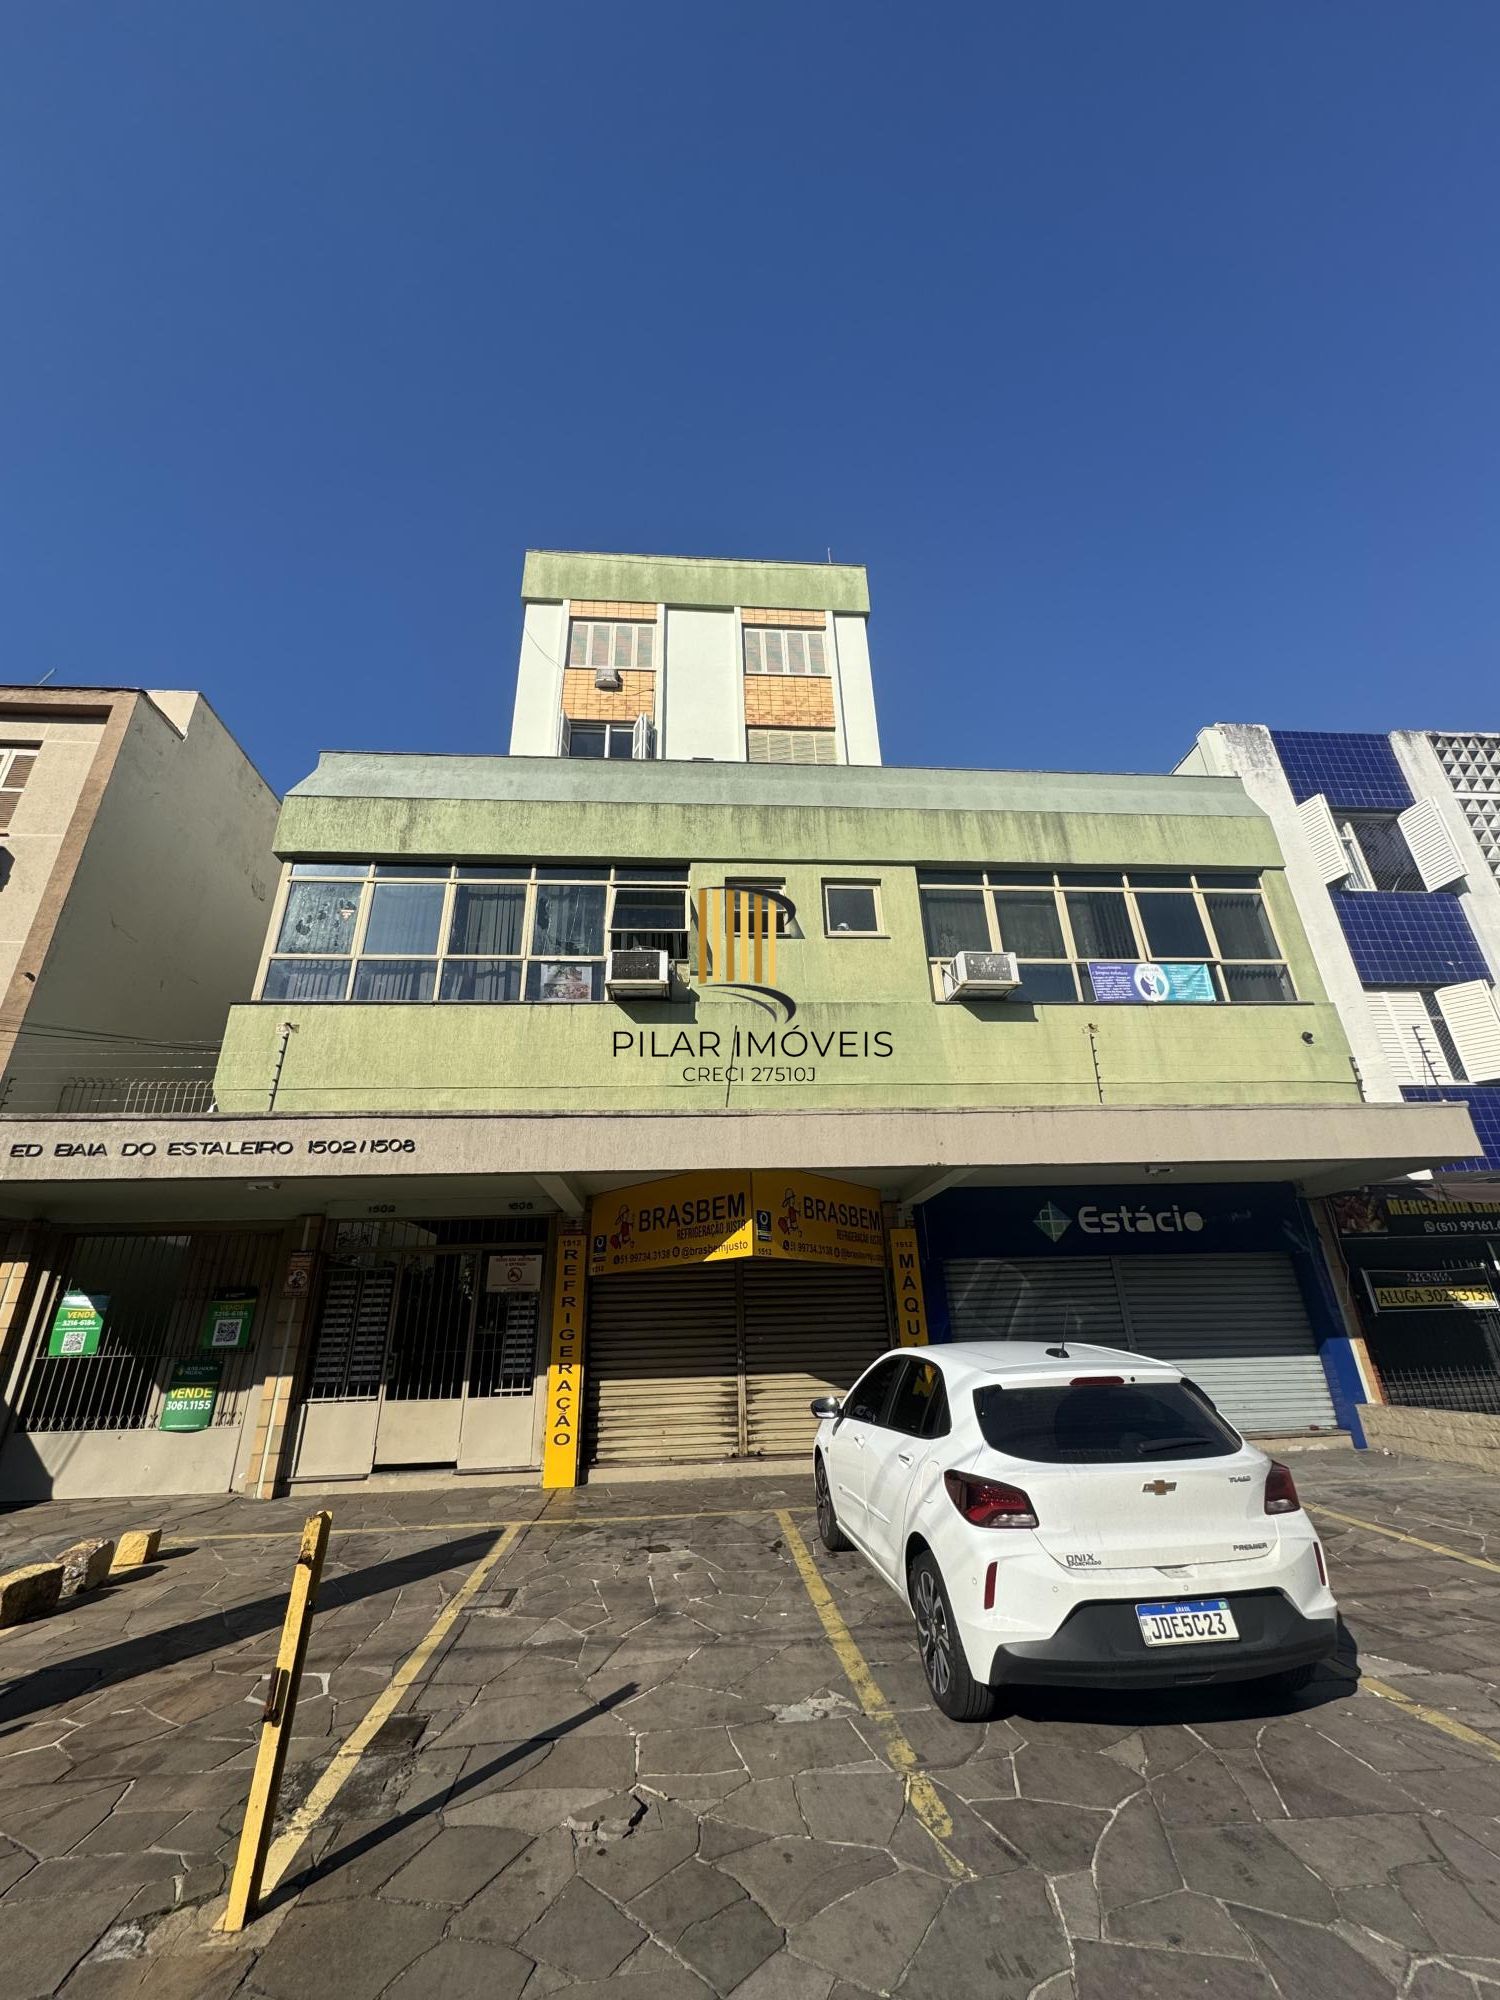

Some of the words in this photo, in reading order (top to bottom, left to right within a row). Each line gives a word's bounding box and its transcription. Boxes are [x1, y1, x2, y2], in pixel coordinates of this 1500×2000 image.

[10, 1143, 43, 1158] ED
[54, 1143, 108, 1158] BAIA
[121, 1142, 157, 1157] DO
[167, 1141, 294, 1157] ESTALEIRO
[368, 1205, 396, 1213] 1502
[639, 1192, 745, 1232] BRASBEM
[803, 1196, 881, 1231] BRASBEM
[1386, 1199, 1473, 1215] MERCEARIA
[725, 1219, 746, 1233] JUSTO
[1077, 1204, 1203, 1234] Estácio
[898, 1253, 920, 1347] MÁQU
[1380, 1289, 1422, 1304] ALUGA
[67, 1311, 97, 1319] VENDE
[553, 1249, 579, 1446] REFRIGERAÇÃO
[171, 1387, 213, 1399] VENDE
[166, 1400, 211, 1410] 3061.1155
[1233, 1542, 1268, 1552] PREMIER
[1066, 1553, 1094, 1563] ONIX
[1151, 1612, 1227, 1640] JDE5C23
